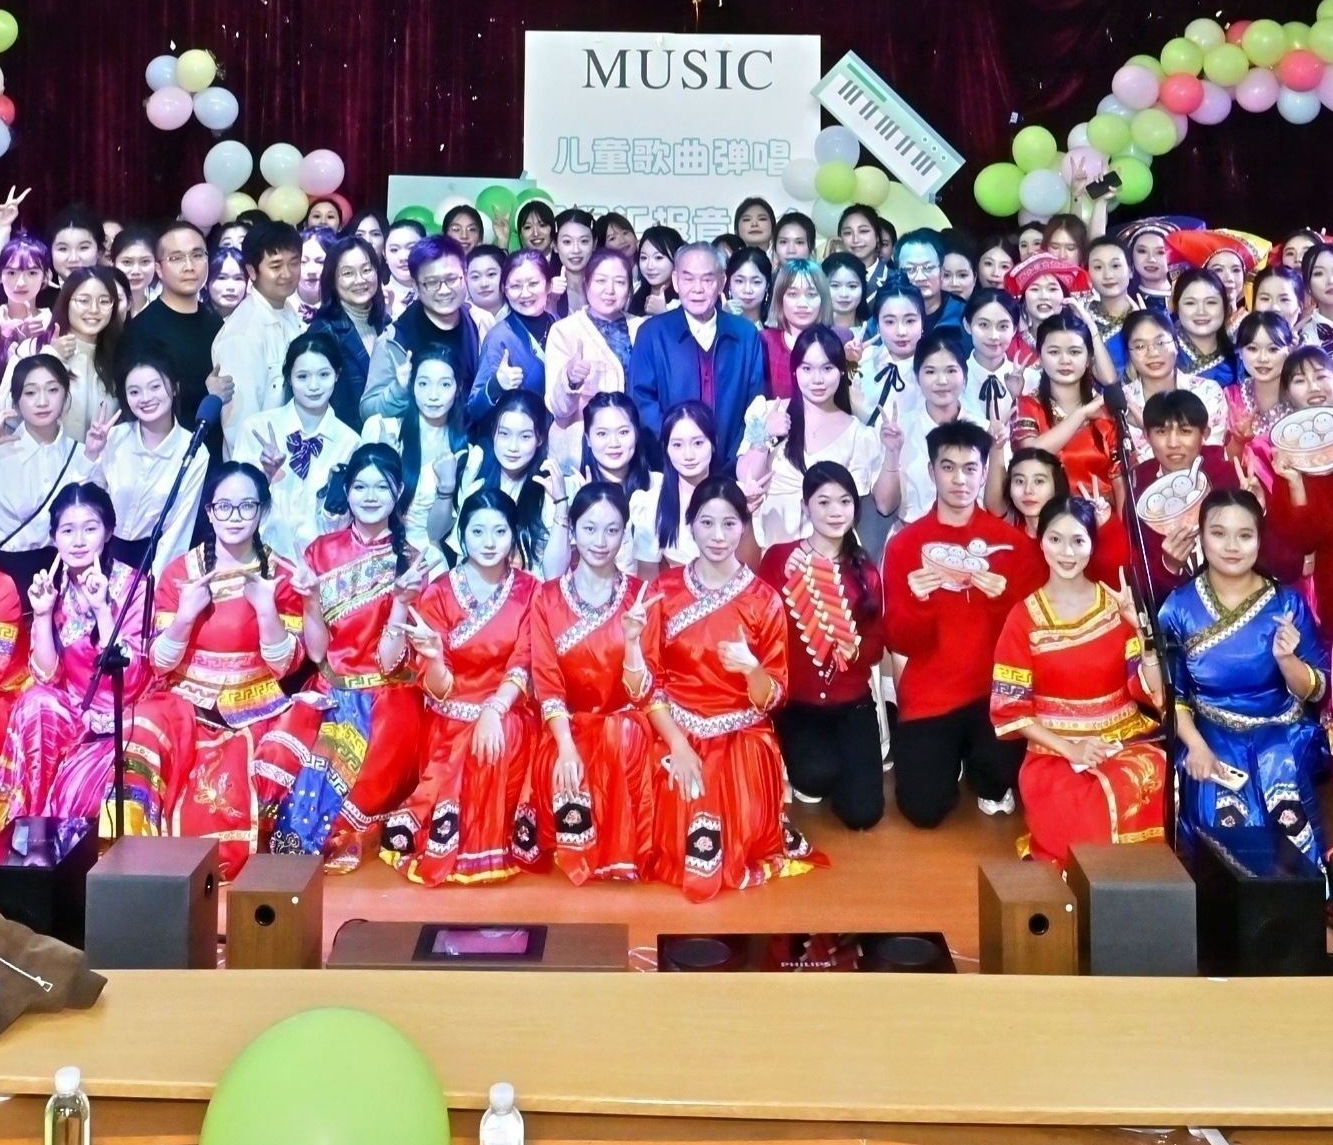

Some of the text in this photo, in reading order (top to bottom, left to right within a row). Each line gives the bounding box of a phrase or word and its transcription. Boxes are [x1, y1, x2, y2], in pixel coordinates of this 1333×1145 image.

[582, 48, 774, 91] MUSIC
[551, 136, 792, 177] 儿童歌曲弹唱
